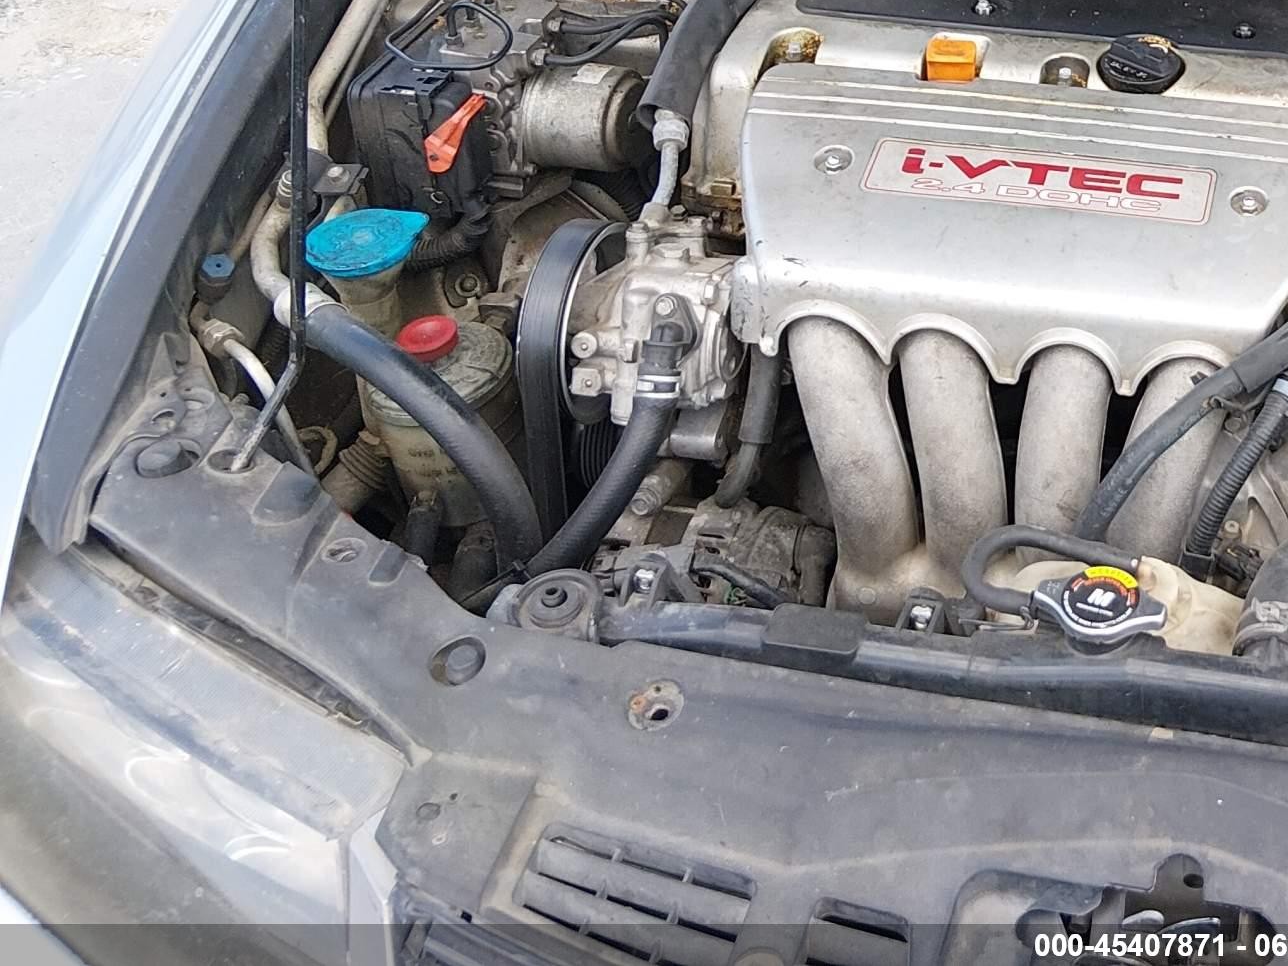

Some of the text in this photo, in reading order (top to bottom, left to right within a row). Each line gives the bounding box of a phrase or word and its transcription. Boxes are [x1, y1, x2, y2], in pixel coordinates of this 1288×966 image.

[902, 148, 1183, 200] i-VTEC
[911, 177, 1162, 212] 2.4 DOHC
